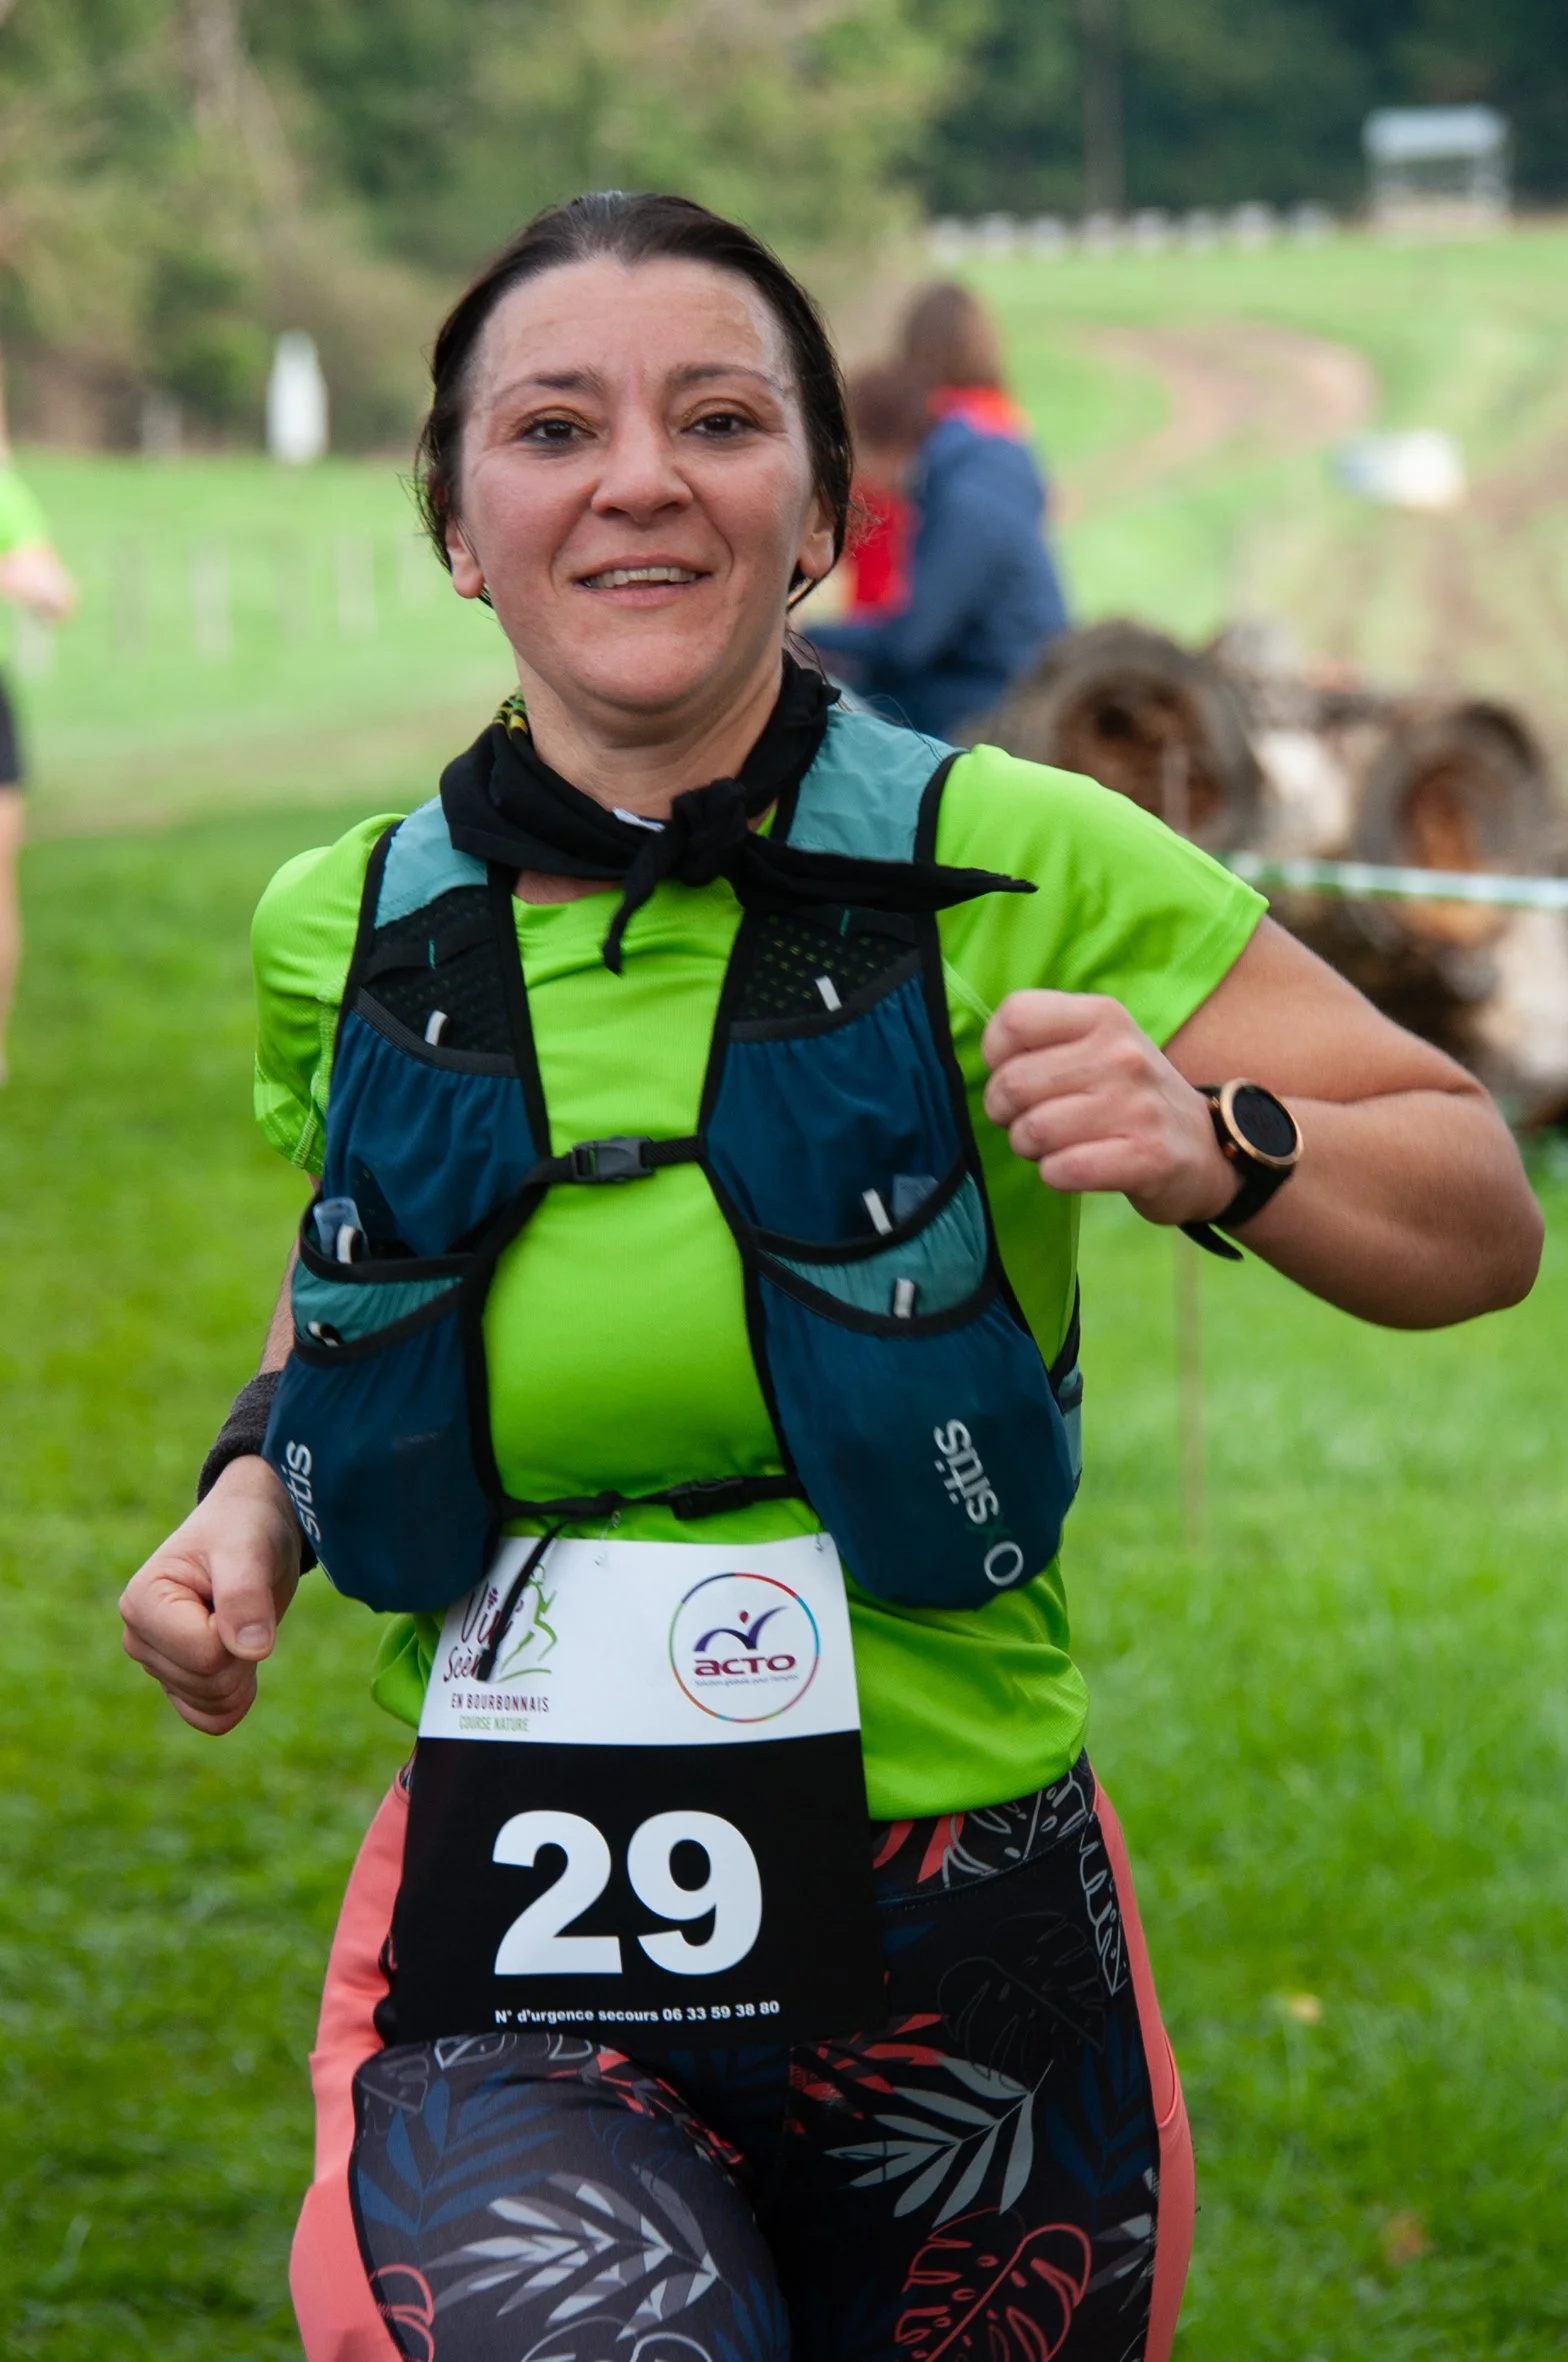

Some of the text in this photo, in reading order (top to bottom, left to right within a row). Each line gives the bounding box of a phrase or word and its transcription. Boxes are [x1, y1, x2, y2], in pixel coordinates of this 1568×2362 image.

[451, 1692, 550, 1713] EN BOURBONNAIS
[459, 1715, 529, 1732] COURSE NATURE
[492, 1809, 763, 1975] 29
[517, 2008, 595, 2025] d'urgence
[598, 2009, 660, 2022] secours
[662, 2007, 683, 2021] 06
[686, 2006, 707, 2021] 33
[711, 2005, 731, 2019] 59
[735, 2003, 756, 2017] 38
[759, 2000, 781, 2015] 80
